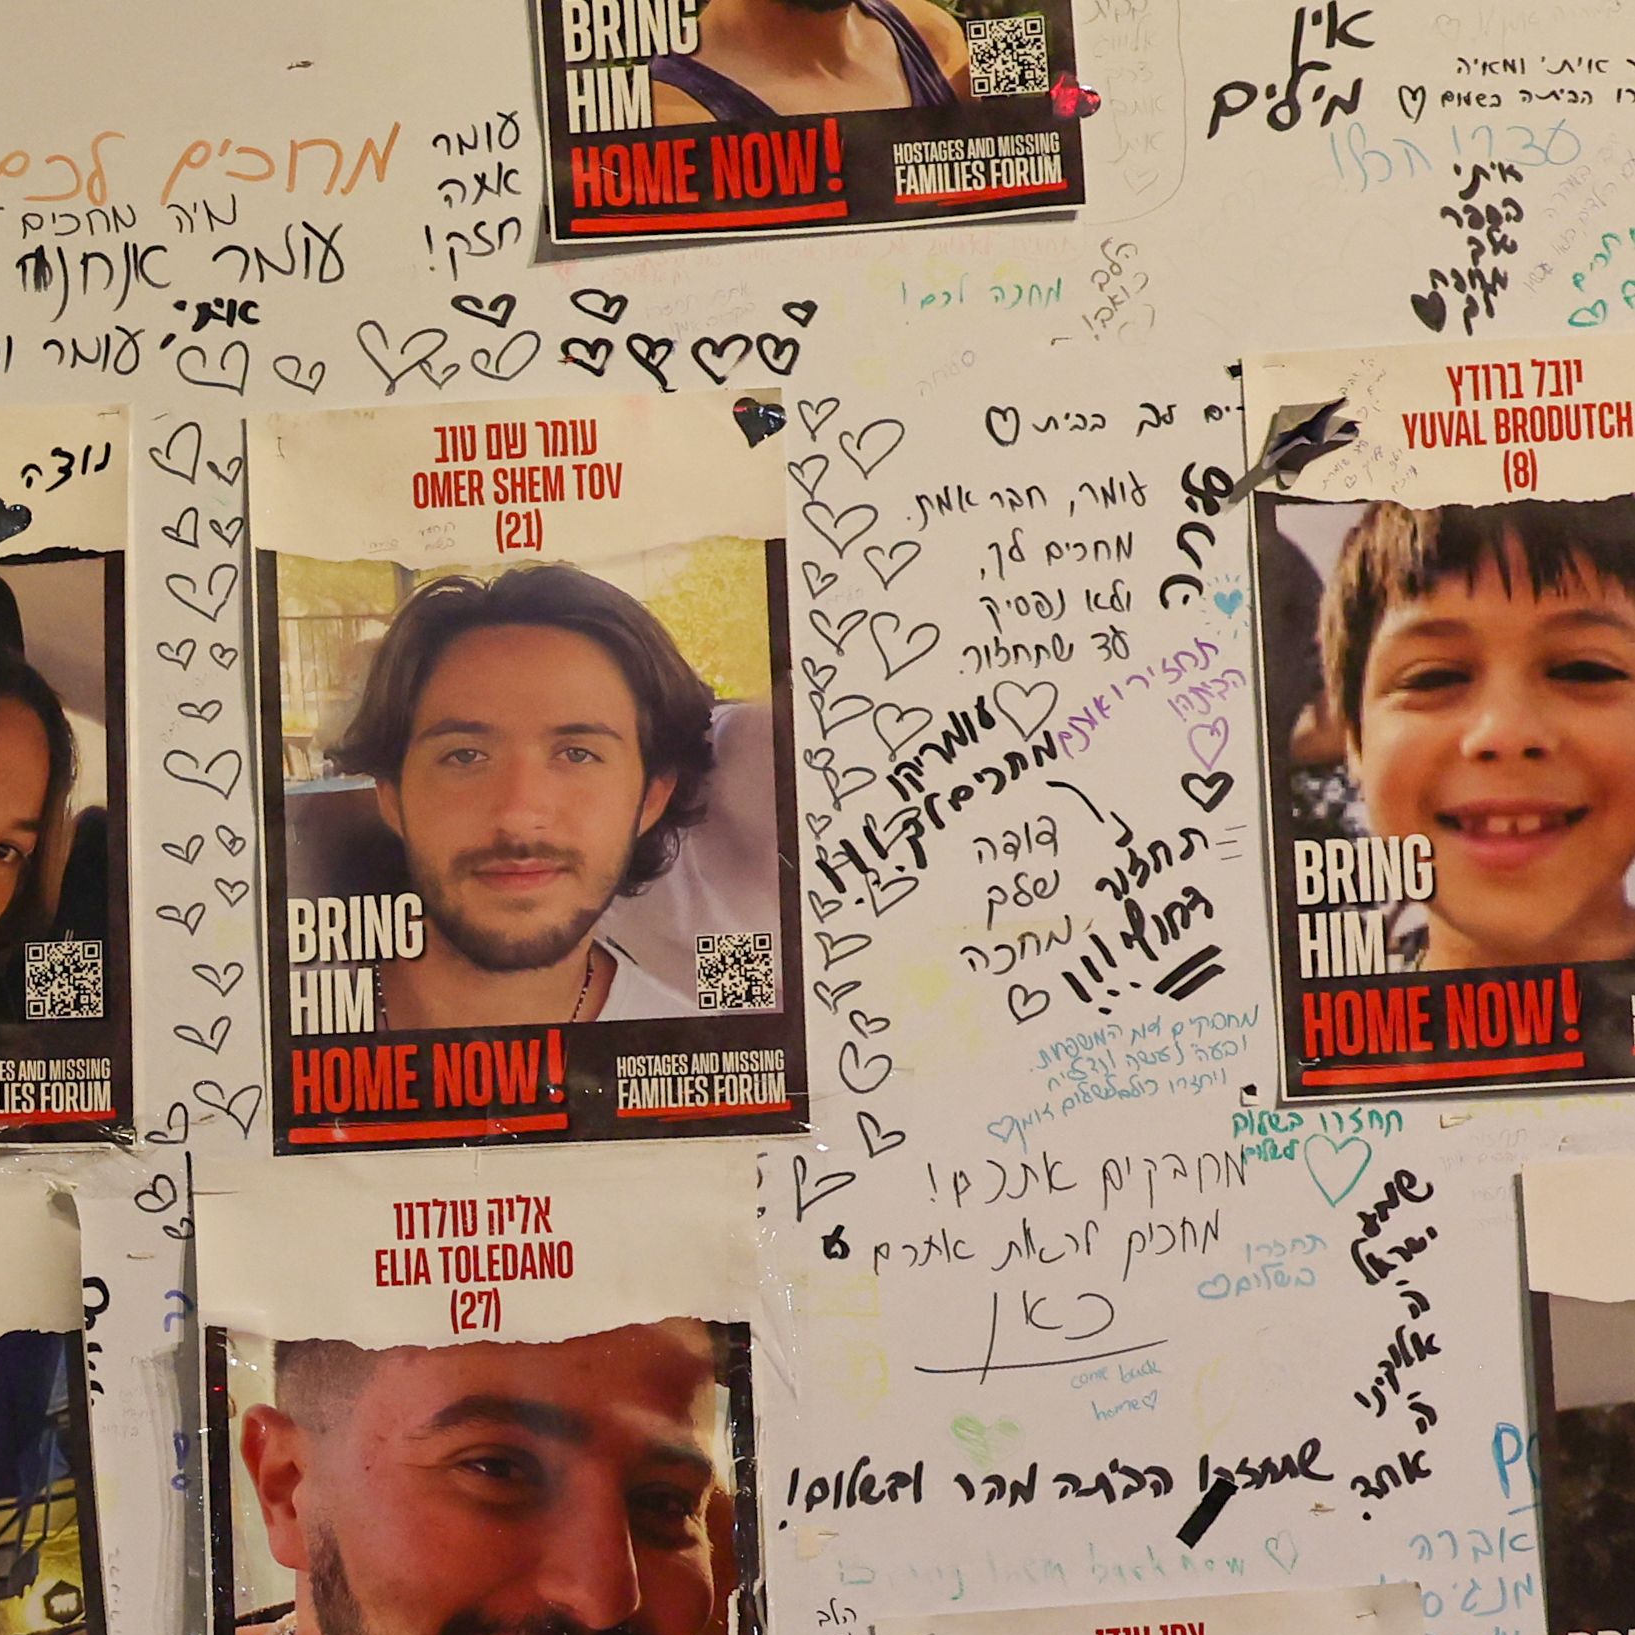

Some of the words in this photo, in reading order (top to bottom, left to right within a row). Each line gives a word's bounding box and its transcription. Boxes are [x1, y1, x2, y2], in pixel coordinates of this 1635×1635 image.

[562, 0, 698, 62] BRING
[566, 65, 652, 133] HIM
[432, 111, 519, 155] עומר
[893, 140, 964, 164] HOSTAGES
[967, 137, 995, 159] AND
[998, 132, 1060, 158] MISSING
[571, 138, 700, 208] HOME
[710, 118, 844, 201] NOW!
[896, 160, 986, 194] FAMILIES
[990, 153, 1062, 187] FORUM
[1446, 363, 1523, 406] ברודץ
[1531, 359, 1582, 397] יובל
[434, 425, 476, 463] טוב
[486, 423, 526, 460] שם
[535, 419, 596, 457] עומר
[1402, 410, 1487, 448] YUVAL
[1494, 401, 1633, 444] BRODUTCH
[413, 470, 484, 509] OMER
[493, 465, 564, 504] SHEM
[572, 463, 622, 500] TOV
[1504, 449, 1537, 492] (8)
[496, 509, 542, 553] (21)
[18, 1060, 46, 1081] AND
[50, 1058, 110, 1080] MISSING
[40, 1081, 111, 1112] FORUM
[394, 1199, 477, 1240] טולדנו
[487, 1195, 552, 1235] אליה
[376, 1248, 431, 1286] ELIA
[438, 1241, 573, 1283] TOLEDANO
[451, 1288, 501, 1334] (27)
